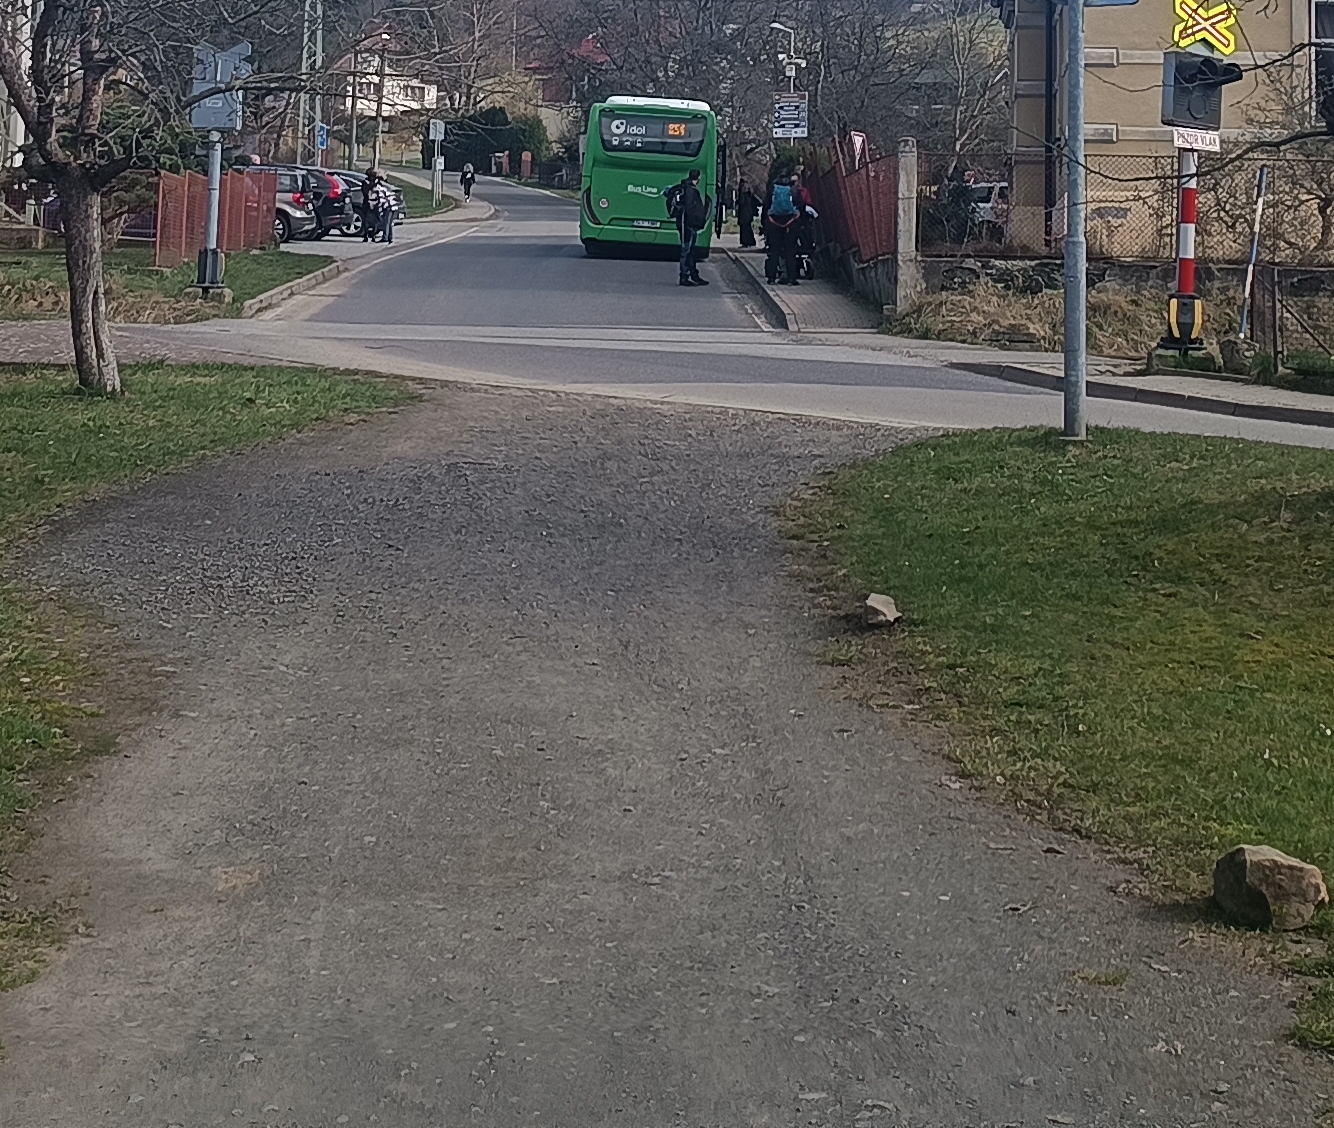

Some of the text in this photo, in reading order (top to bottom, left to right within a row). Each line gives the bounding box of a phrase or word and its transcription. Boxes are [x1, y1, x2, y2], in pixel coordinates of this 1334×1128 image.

[1176, 132, 1217, 147] POZOR VLAK
[627, 184, 657, 193] Bus Line
